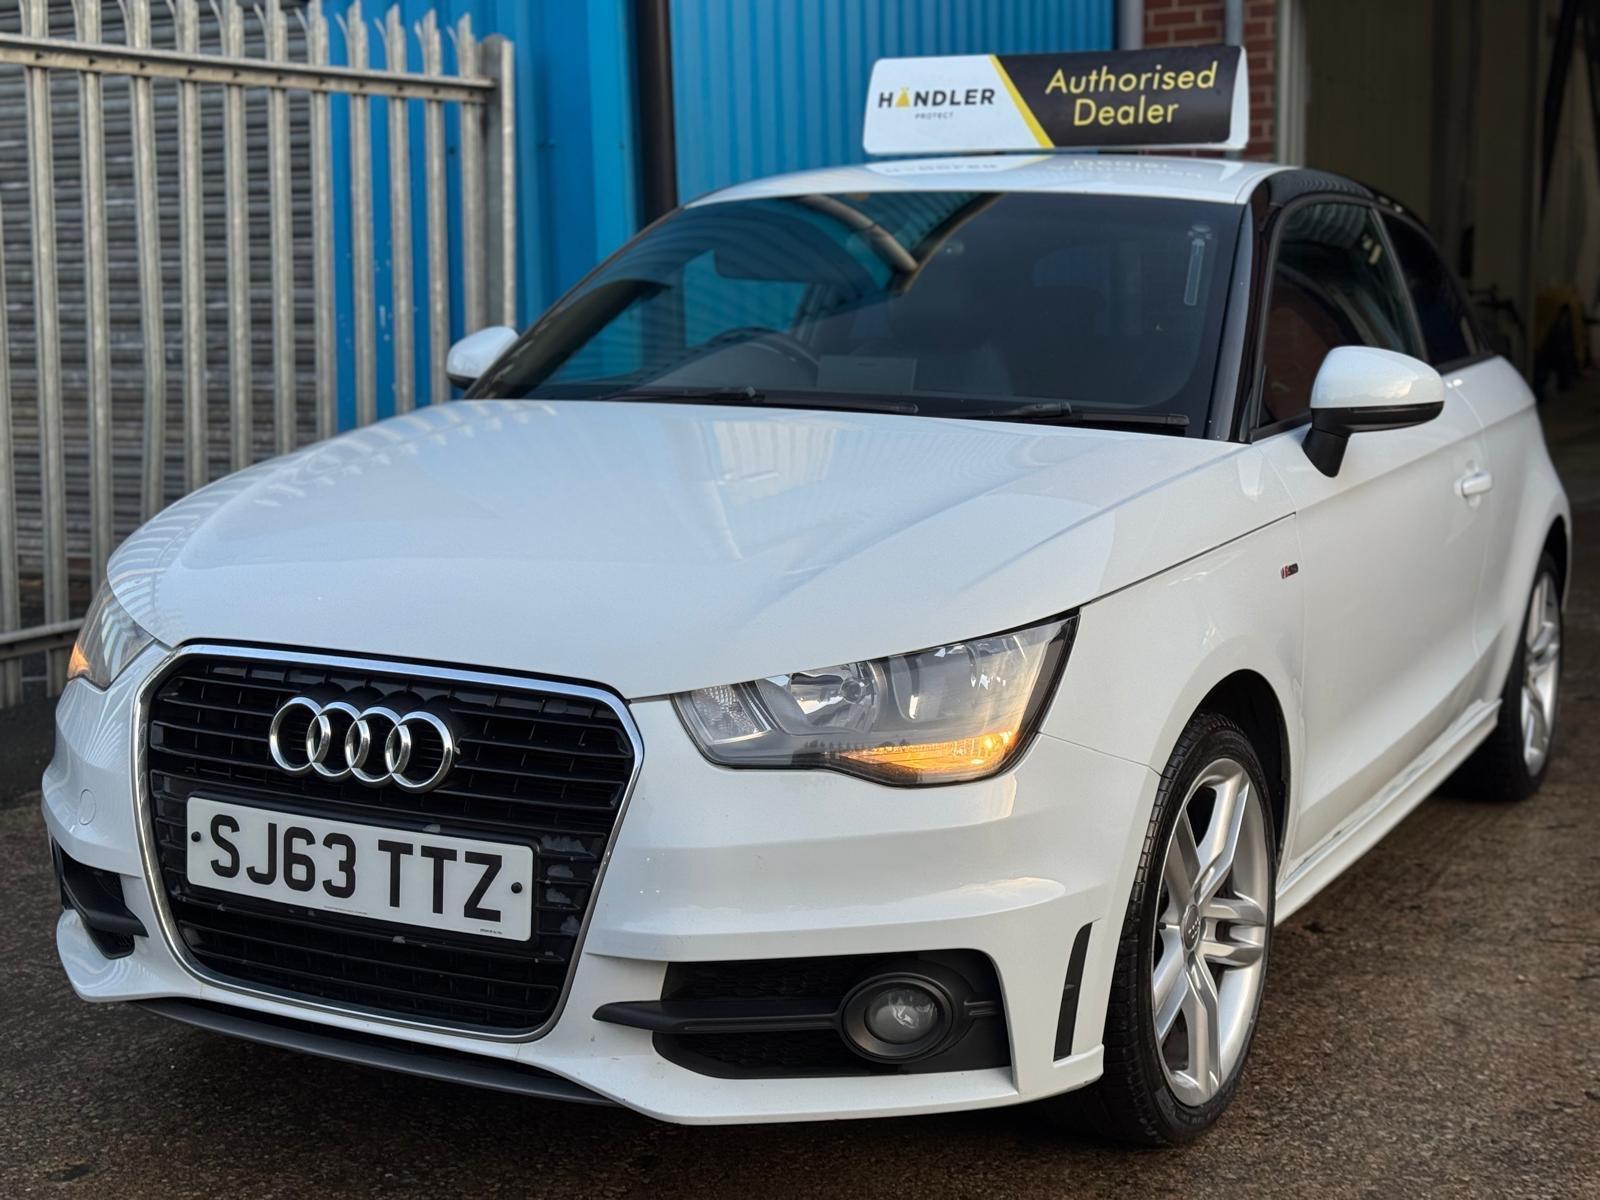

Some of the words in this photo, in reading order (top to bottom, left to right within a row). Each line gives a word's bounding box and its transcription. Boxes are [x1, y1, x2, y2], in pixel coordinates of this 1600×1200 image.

[1045, 60, 1219, 95] Authorised
[914, 111, 954, 120] PROTECT
[1073, 95, 1180, 126] Dealer
[210, 813, 357, 899] SJ63
[377, 838, 503, 923] TTZ
